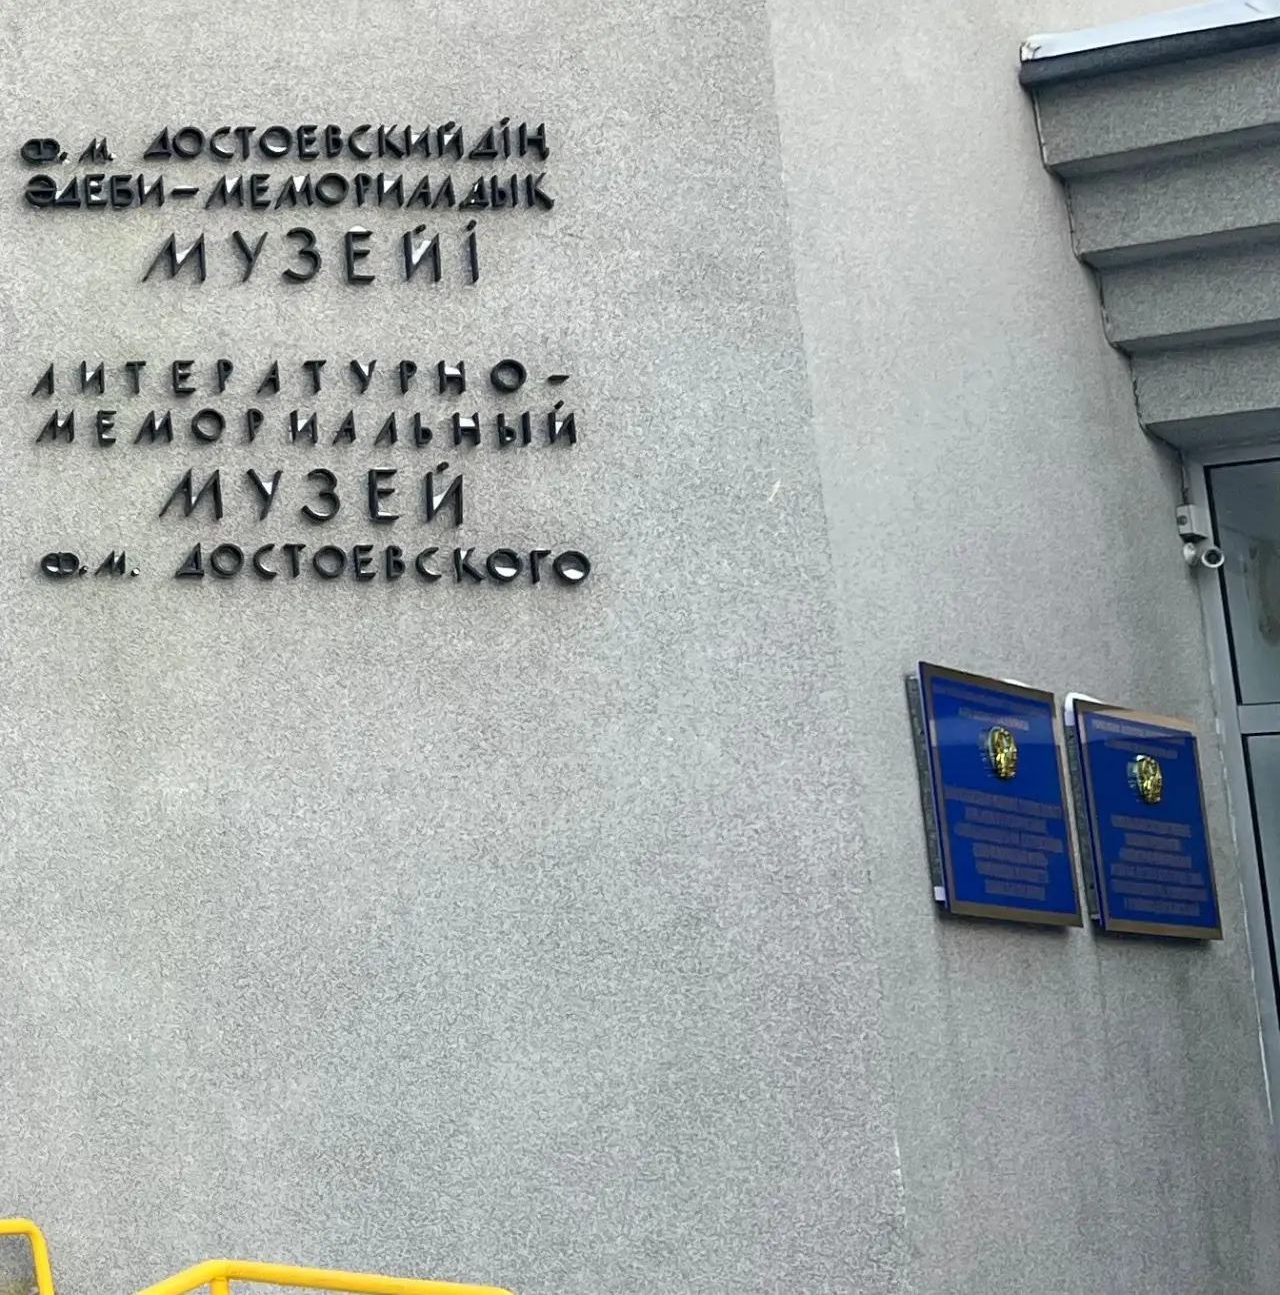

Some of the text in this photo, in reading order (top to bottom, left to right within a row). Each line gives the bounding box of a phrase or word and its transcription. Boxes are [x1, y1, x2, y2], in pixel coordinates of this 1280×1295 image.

[143, 117, 550, 161] ДОСТОЕВСКИЙДІҢ
[142, 220, 479, 283] МУЗЕЙІ
[31, 359, 569, 396] ЛИТЕРАТУРНО-
[35, 400, 576, 446] МЕМОРИАЛЬНЫЙ
[159, 462, 463, 526] МУЗЕЙ
[174, 542, 591, 586] ДОСТОЕВСКОГО
